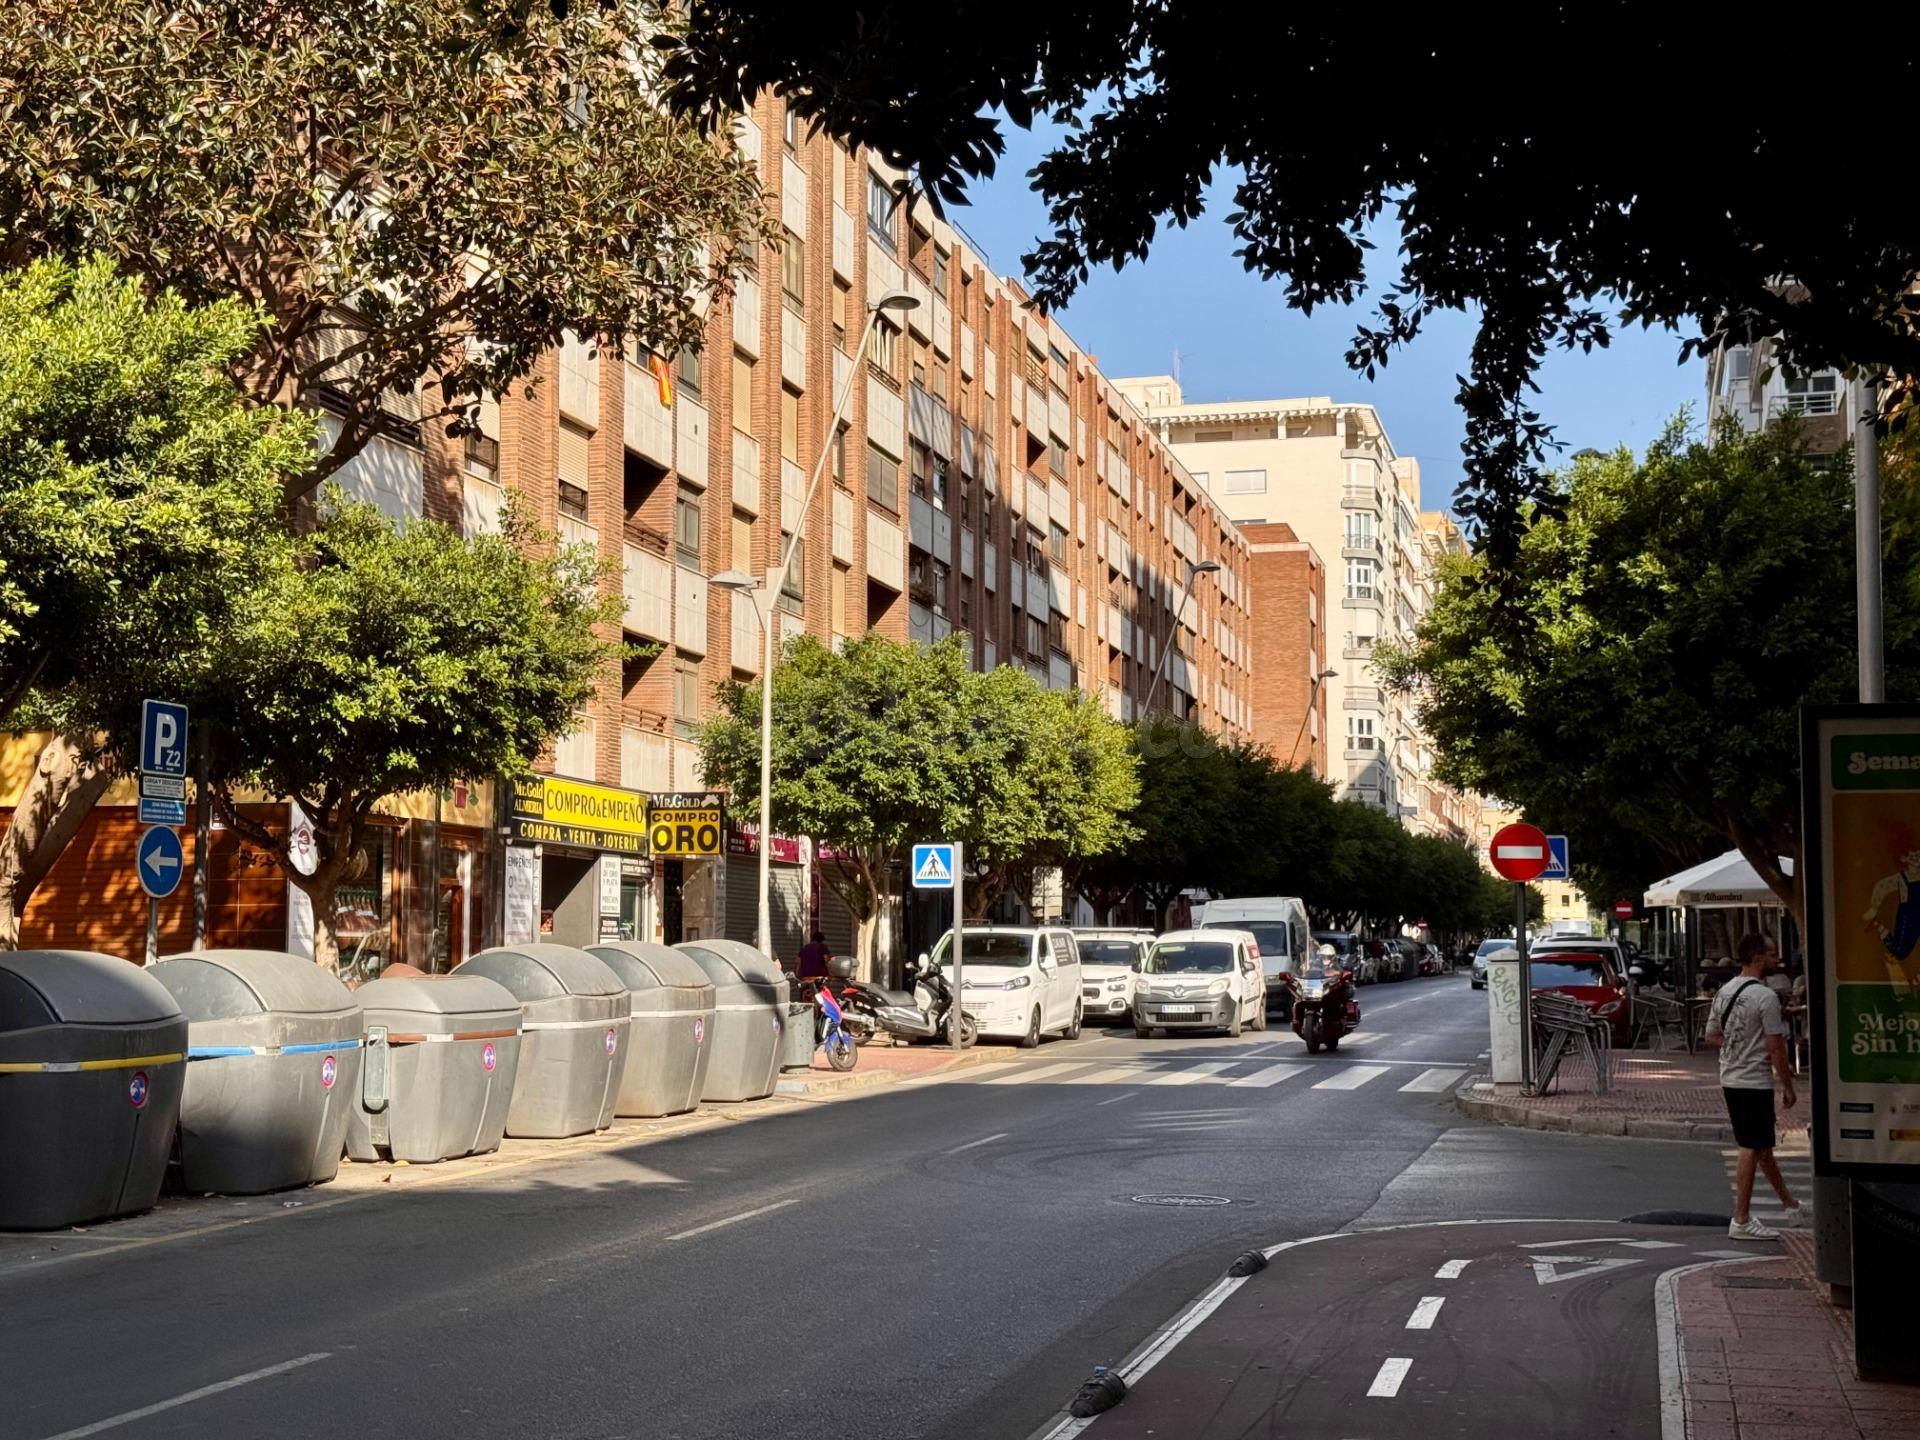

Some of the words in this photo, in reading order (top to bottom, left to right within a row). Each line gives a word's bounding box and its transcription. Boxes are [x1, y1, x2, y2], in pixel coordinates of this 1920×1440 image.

[154, 712, 177, 766] P
[165, 749, 181, 767] Z2
[514, 780, 543, 799] Mr.Gold
[652, 811, 719, 823] COMPRO
[520, 821, 561, 842] COMPRA
[569, 829, 596, 846] VENTA
[652, 825, 719, 852] ORO
[1851, 1031, 1899, 1056] Sin
